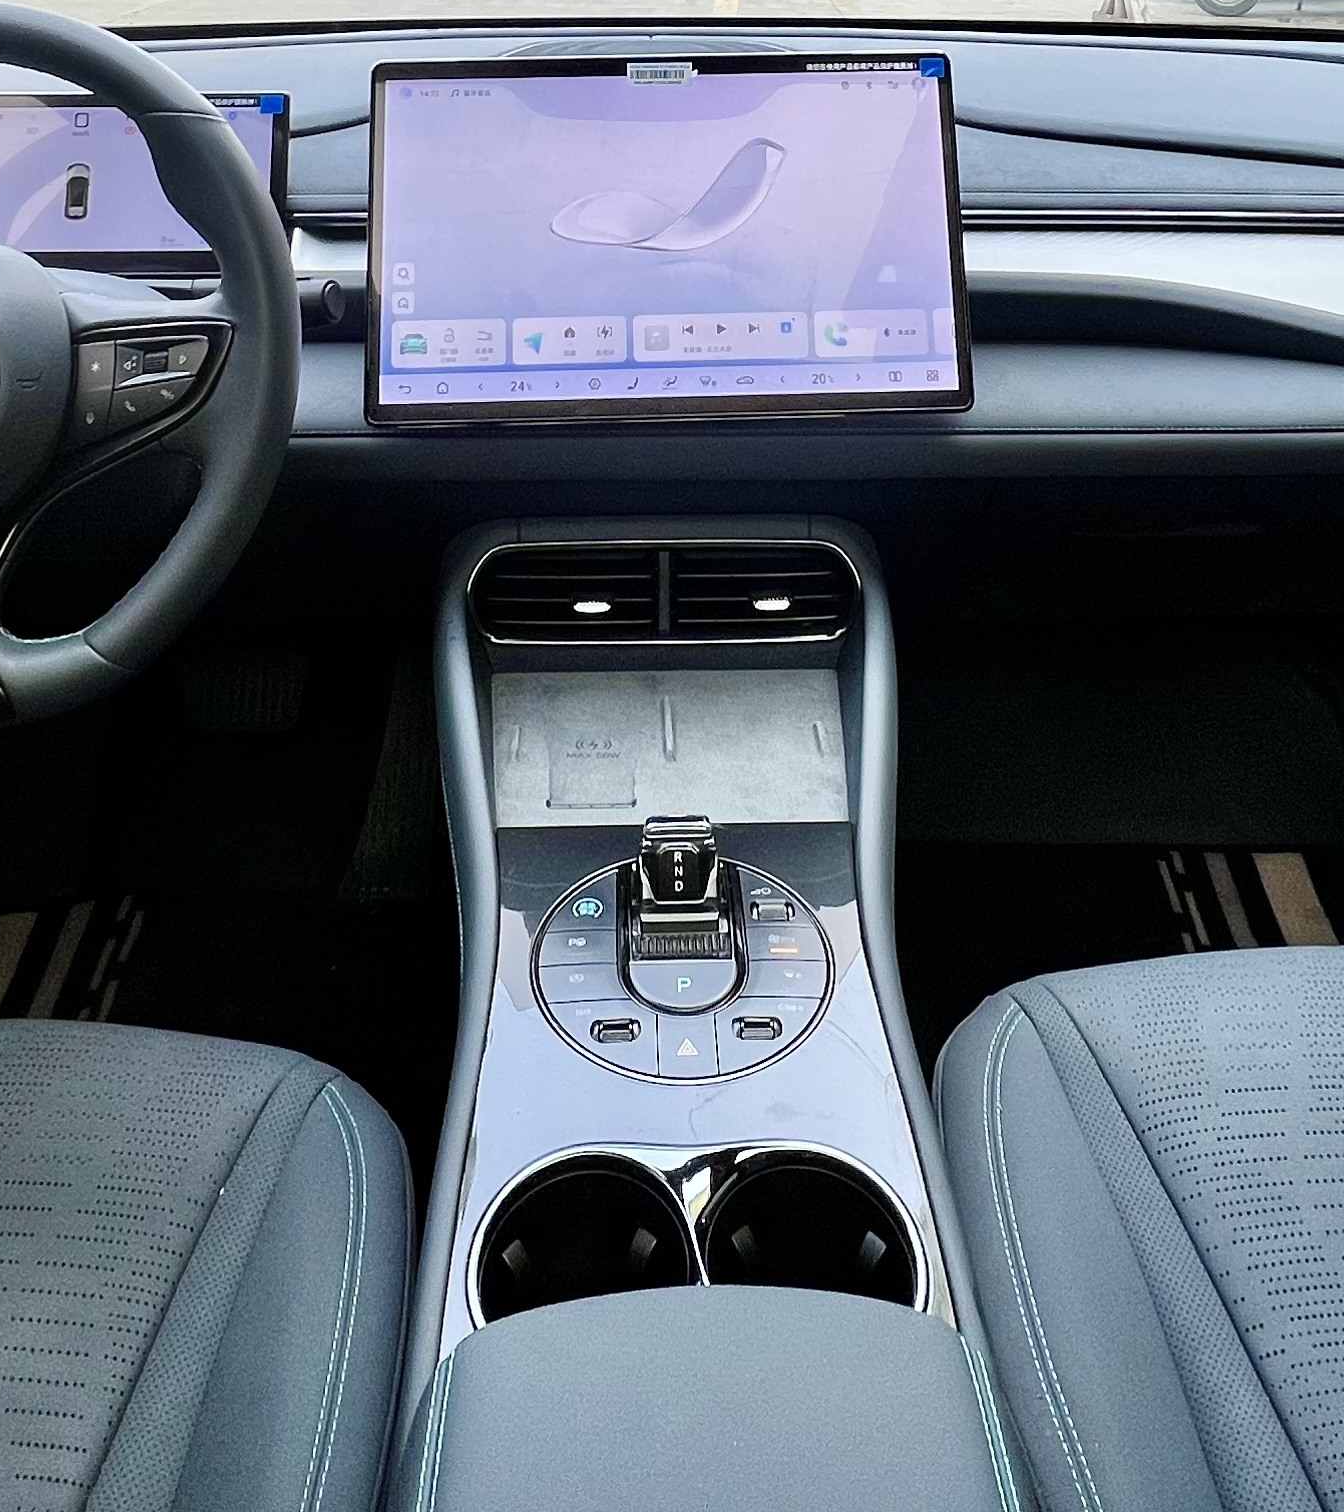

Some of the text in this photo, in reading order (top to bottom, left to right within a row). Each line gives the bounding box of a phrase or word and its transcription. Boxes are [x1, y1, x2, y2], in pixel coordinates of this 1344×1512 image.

[673, 851, 683, 863] R
[674, 866, 683, 877] N
[674, 880, 684, 892] D
[677, 977, 692, 993] P
